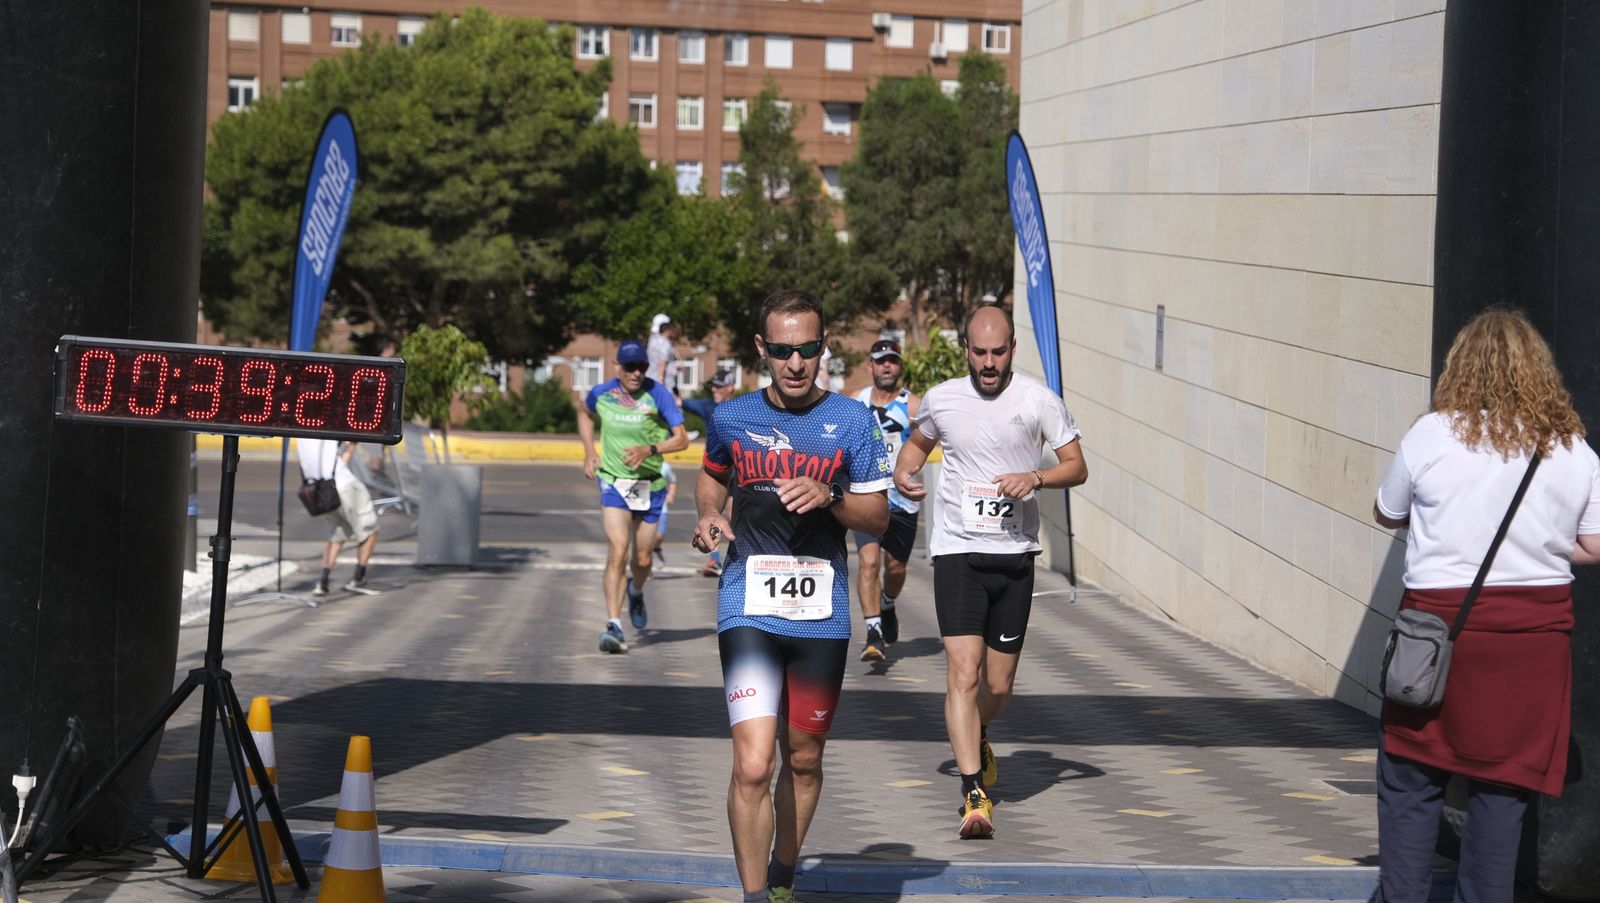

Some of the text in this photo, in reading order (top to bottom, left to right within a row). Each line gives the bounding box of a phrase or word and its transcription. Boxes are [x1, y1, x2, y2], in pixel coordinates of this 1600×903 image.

[76, 349, 386, 430] 00:39:20
[975, 500, 1014, 518] 132
[764, 577, 816, 598] 140
[728, 687, 757, 703] GALO
